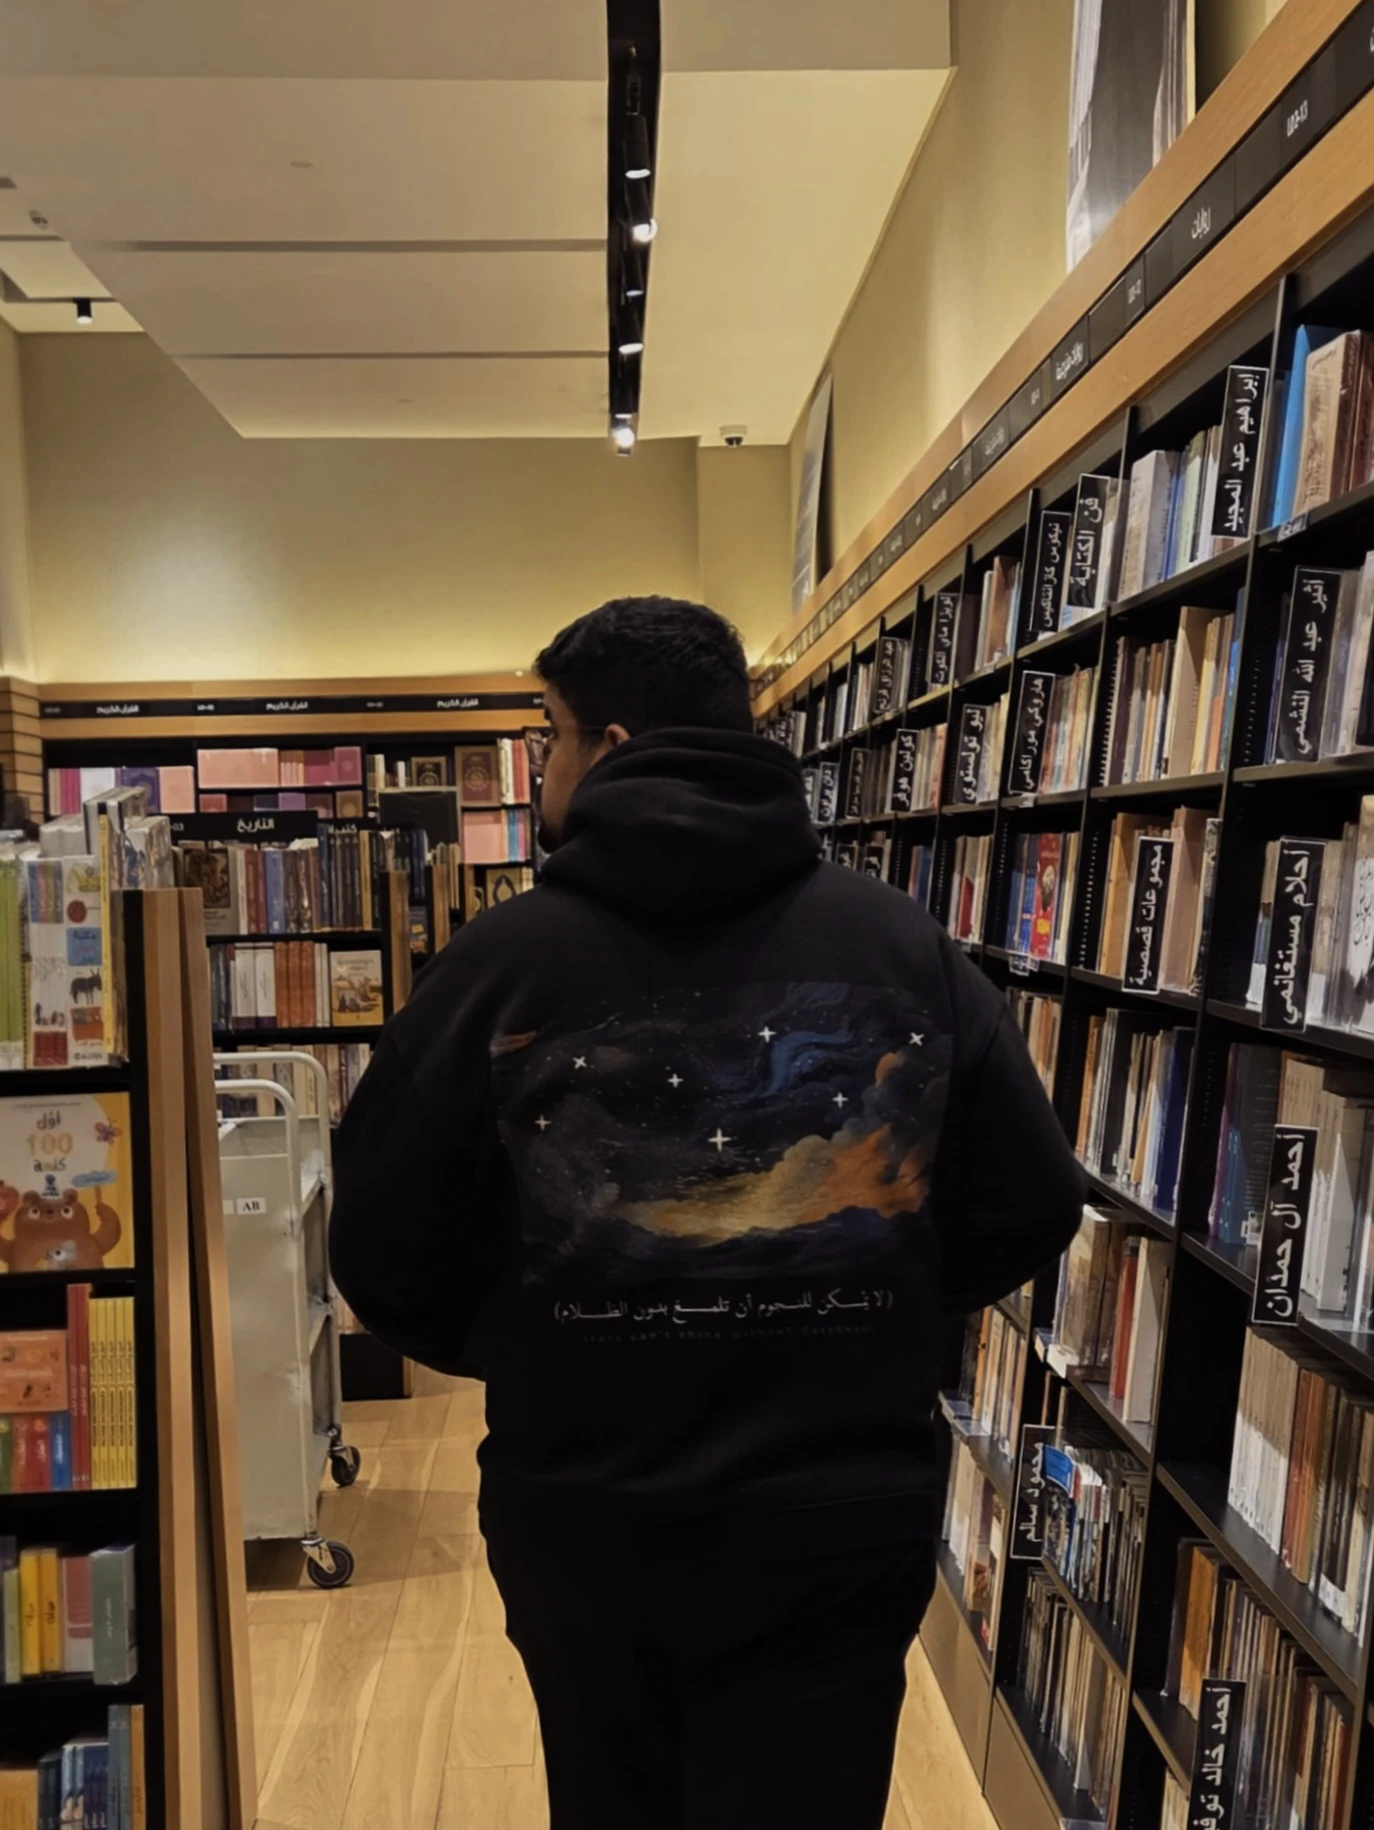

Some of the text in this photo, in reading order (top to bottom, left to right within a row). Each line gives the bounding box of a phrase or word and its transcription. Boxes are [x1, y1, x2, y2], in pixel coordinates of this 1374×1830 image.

[1223, 373, 1260, 532] إبراهيم عبد المجيد
[1070, 497, 1103, 587] فن الكتابة
[1289, 578, 1328, 754] أثير عبد الله النشمي
[892, 734, 916, 808] كولين هوفر
[959, 708, 984, 801] ليو تولستوي
[1018, 677, 1046, 790] هاروكي موراكامي
[236, 817, 275, 834] التاريخ
[1129, 844, 1165, 986] مجموعات قصصية
[1273, 849, 1315, 1025] أحلام مستغانمي
[25, 1132, 73, 1157] 100
[242, 1200, 261, 1212] AB
[1263, 1132, 1305, 1318] أحمد آل حمدان
[733, 1292, 753, 1319] أن
[1018, 1440, 1045, 1541] محمود سالم
[1205, 1686, 1232, 1735] أحمد
[1200, 1743, 1226, 1786] خالد
